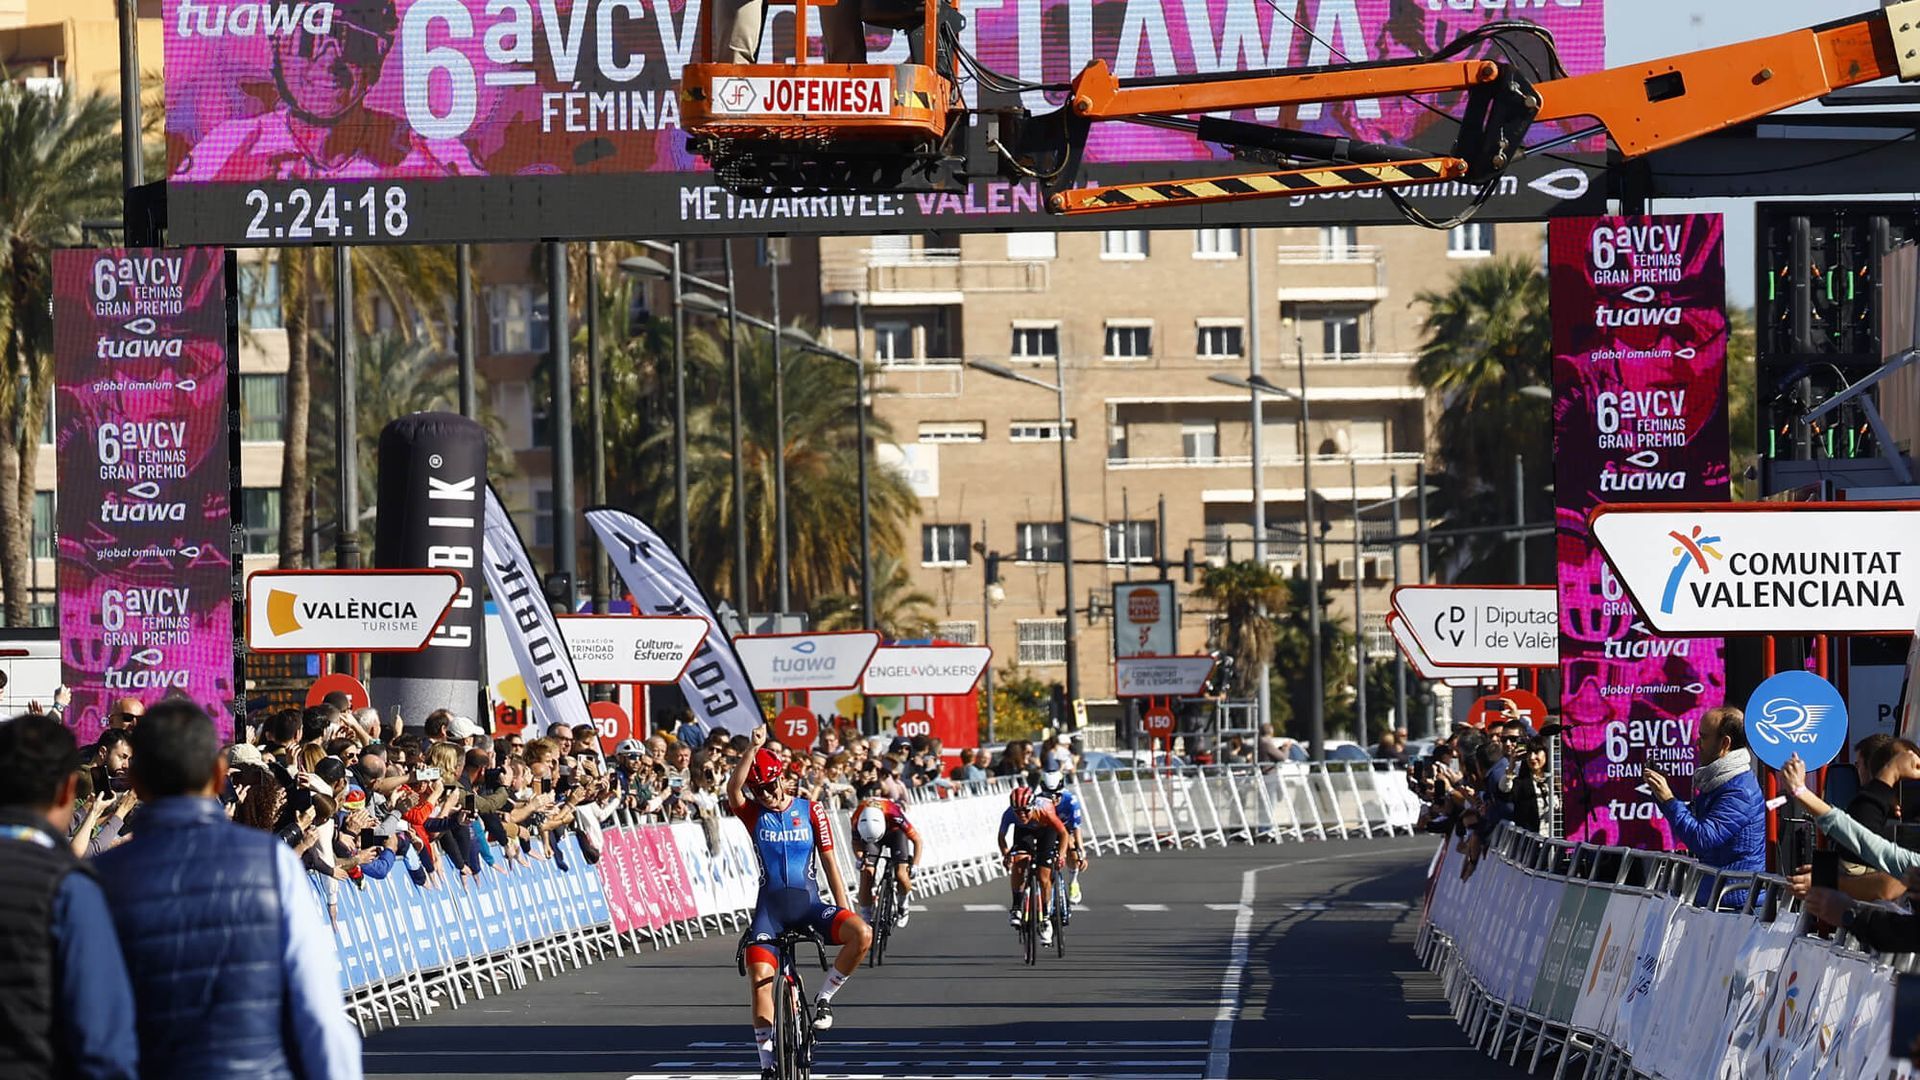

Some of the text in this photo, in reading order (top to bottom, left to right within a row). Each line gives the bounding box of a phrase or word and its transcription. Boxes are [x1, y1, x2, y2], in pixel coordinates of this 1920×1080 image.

[763, 79, 883, 113] JOFEMESA
[542, 81, 683, 133] FÉMINA
[246, 187, 408, 239] 2:24:18
[1594, 268, 1682, 284] GRAN PREMIO
[96, 300, 183, 316] GRAN PREMIO
[1596, 305, 1682, 327] tuawa
[97, 336, 182, 359] tuawa
[1591, 349, 1671, 362] global omnium
[93, 380, 172, 393] global omnium
[1598, 432, 1686, 449] GRAN PREMIO
[100, 464, 186, 480] GRAN PREMIO
[1600, 469, 1687, 492] tuawa
[101, 500, 186, 523] tuawa
[97, 547, 176, 561] global omnium
[1729, 551, 1901, 575] COMUNITAT
[1690, 580, 1905, 608] VALENCIANA
[303, 598, 417, 619] VALÈNCIA
[1486, 606, 1558, 627] Diputac
[362, 622, 418, 631] TURISME
[104, 630, 190, 646] GRAN PREMIO
[635, 639, 673, 650] Cultura
[1485, 632, 1509, 648] de
[571, 645, 614, 653] TRINIDAD
[633, 650, 683, 661] Esfuerzo
[1604, 637, 1690, 659] tuawa
[772, 656, 836, 673] tuawa
[104, 666, 189, 688] tuawa
[1600, 684, 1680, 697] global omnium
[593, 718, 618, 738] 50
[785, 719, 808, 737] 75
[901, 720, 930, 738] 100
[1148, 716, 1170, 728] 150
[1790, 733, 1818, 744] VCV
[1607, 763, 1642, 778] GRAN
[1608, 799, 1664, 820] tua
[813, 804, 832, 846] CERATIZIT
[760, 828, 809, 842] CERATIZIT
